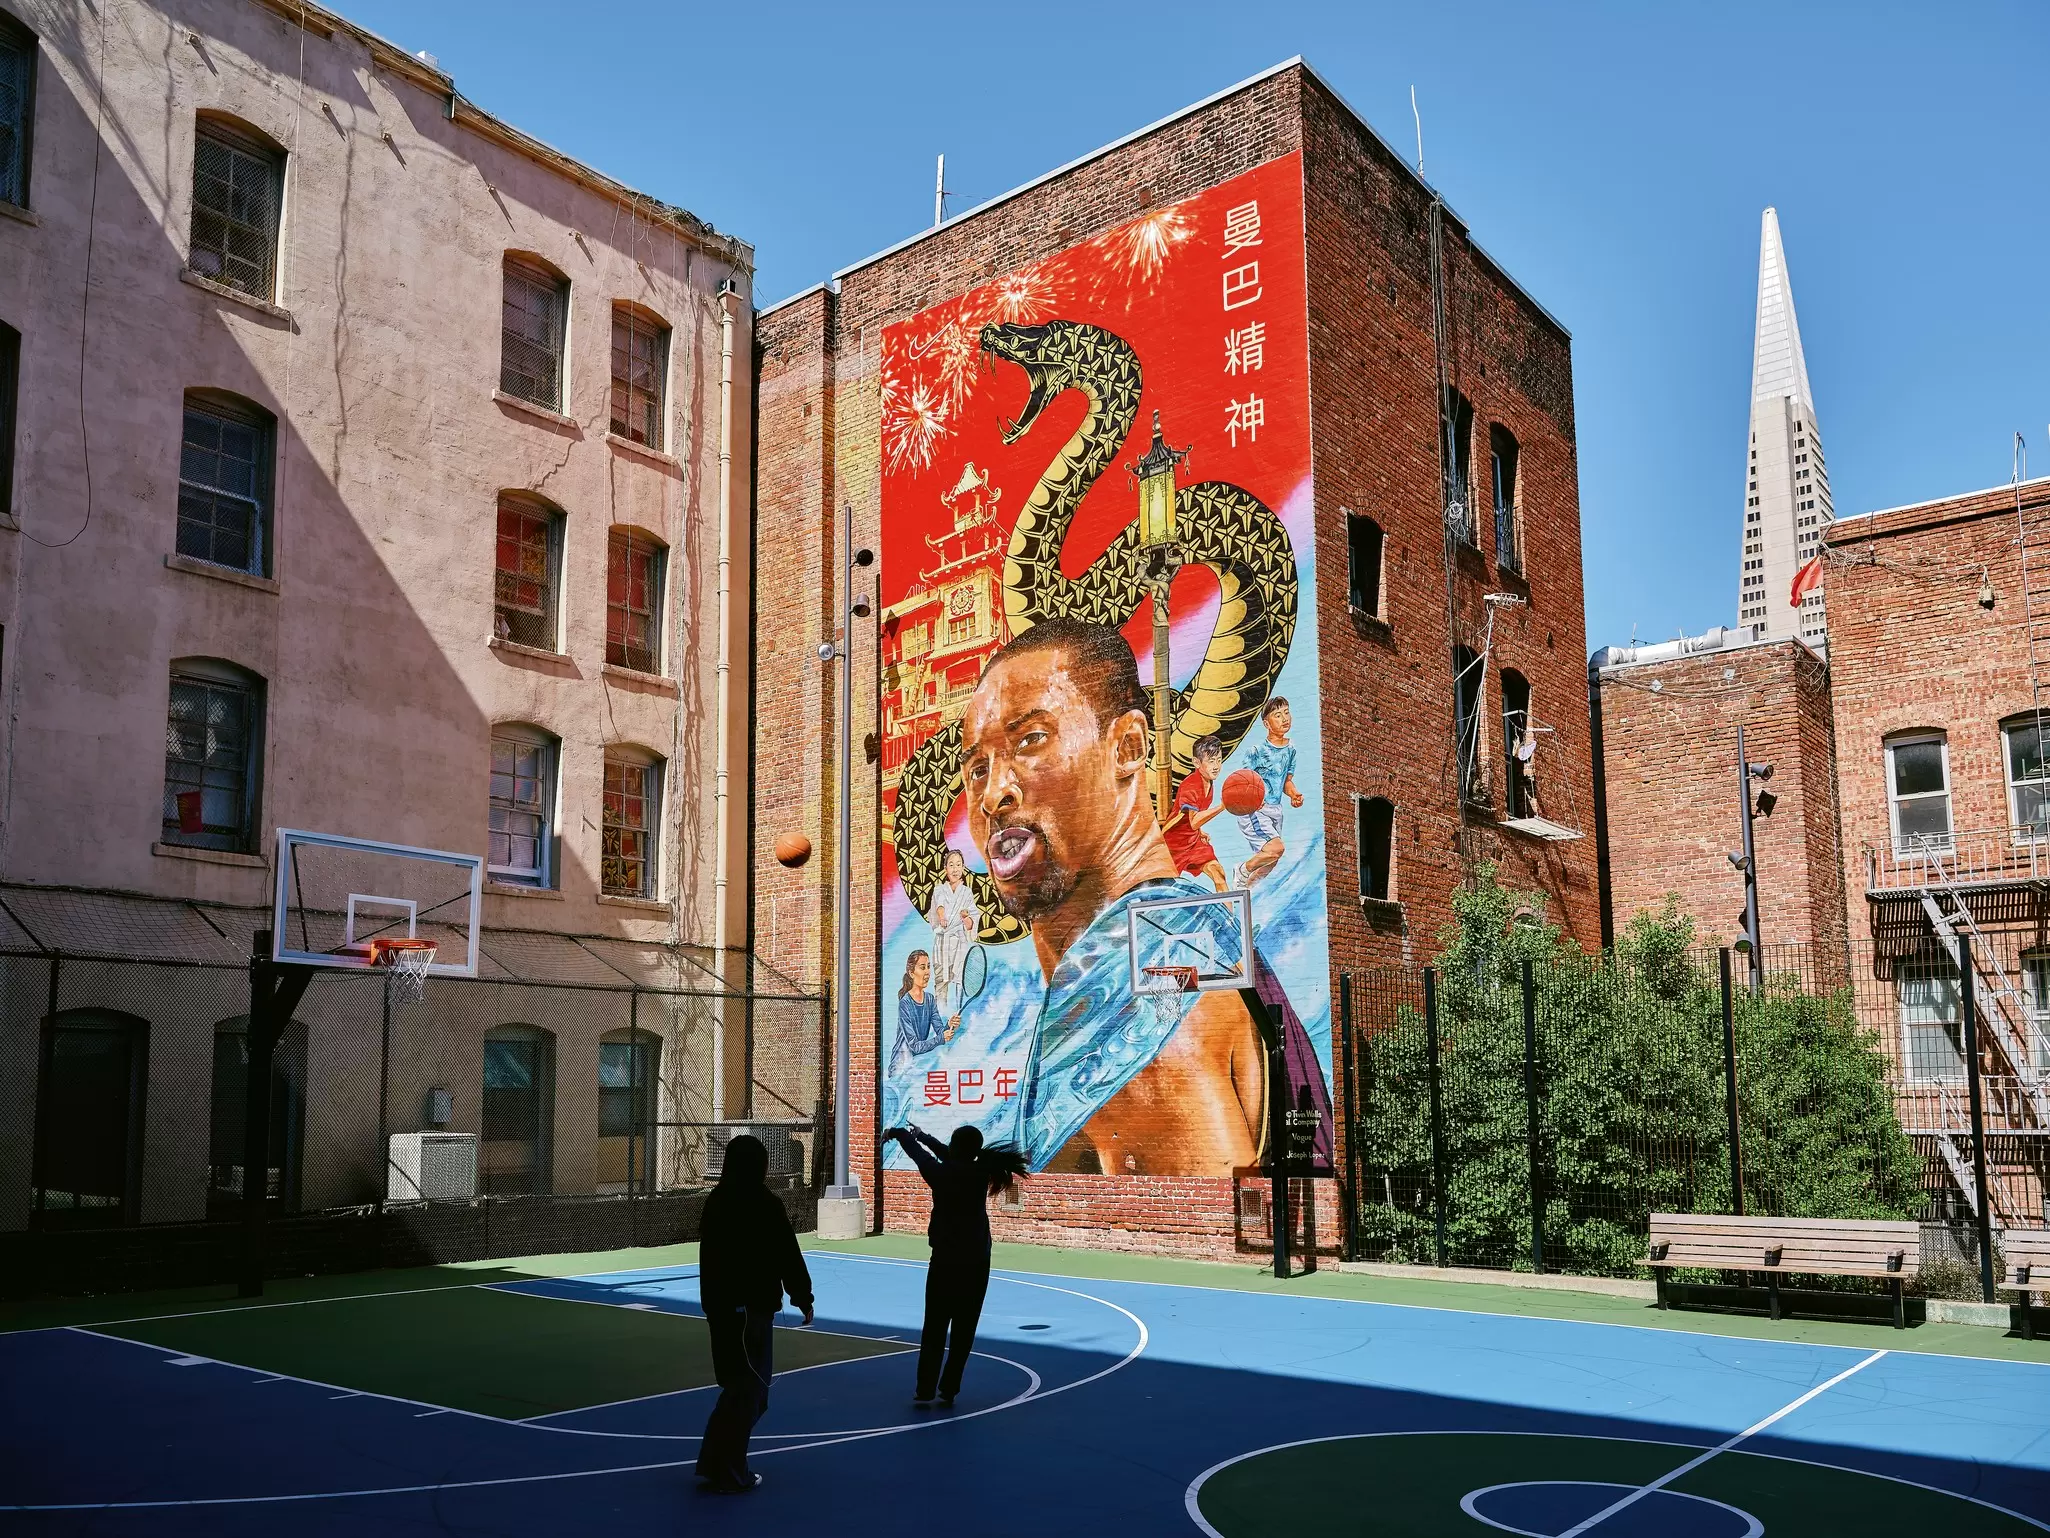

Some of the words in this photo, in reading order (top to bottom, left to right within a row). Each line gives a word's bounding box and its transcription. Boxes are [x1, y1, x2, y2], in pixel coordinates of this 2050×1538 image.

[1221, 199, 1266, 448] 曼巴精神
[923, 1066, 1018, 1107] 曼巴年
[1306, 1110, 1322, 1118] Walls
[1293, 1119, 1320, 1128] Company
[1292, 1133, 1312, 1144] Vogue
[1286, 1150, 1308, 1160] Joseph
